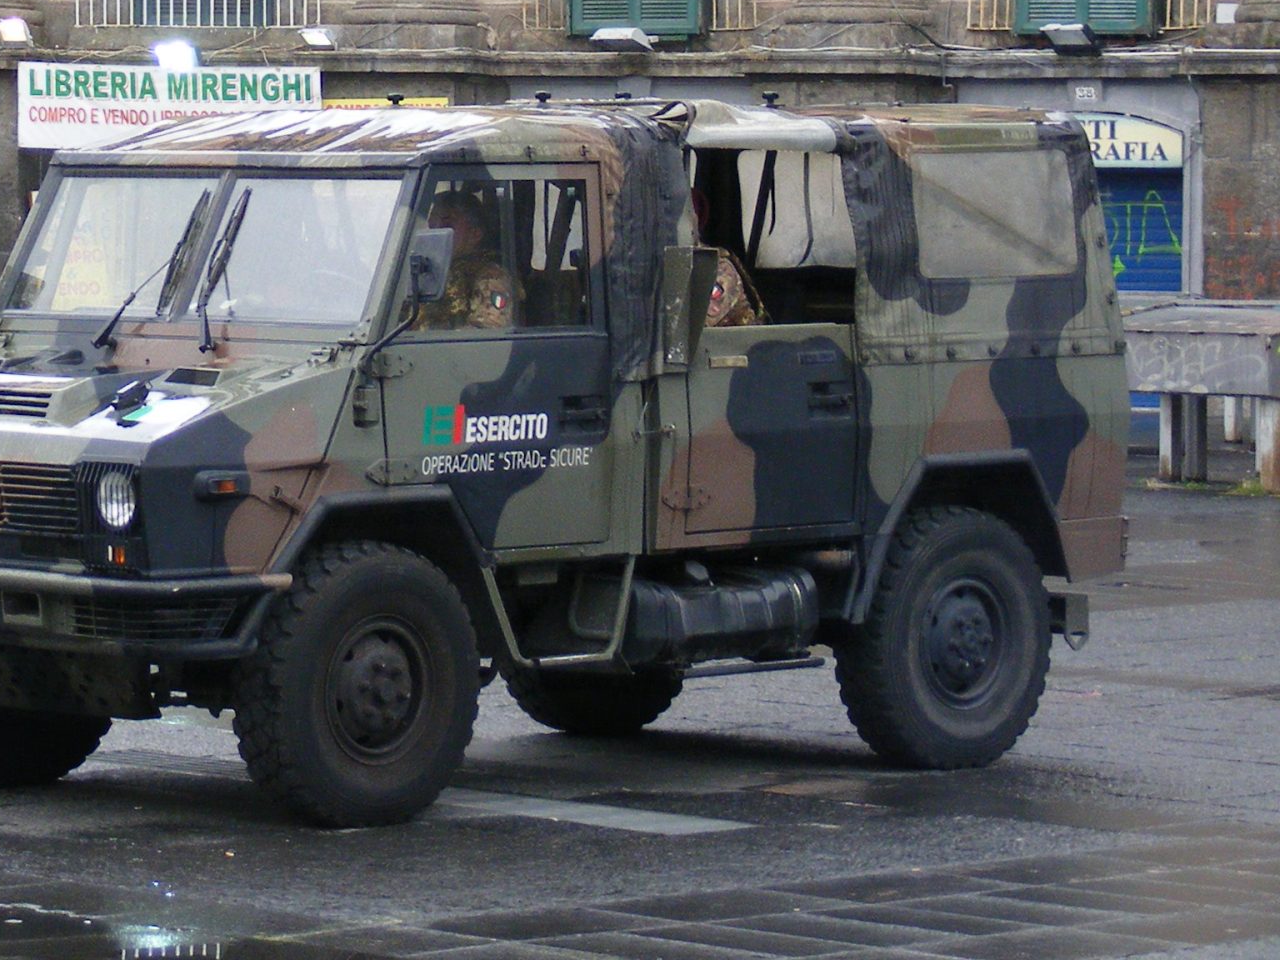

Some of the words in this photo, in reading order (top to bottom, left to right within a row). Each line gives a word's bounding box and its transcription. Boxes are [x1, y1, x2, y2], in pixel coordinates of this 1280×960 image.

[28, 68, 158, 100] LIBRERIA
[167, 73, 313, 102] MIRENGHI
[28, 106, 87, 124] COMPRO
[90, 108, 99, 124] E
[103, 109, 149, 126] VENDO
[1082, 120, 1118, 140] TI
[465, 413, 549, 443] ESERCITO
[422, 452, 495, 475] OPERAZIONE
